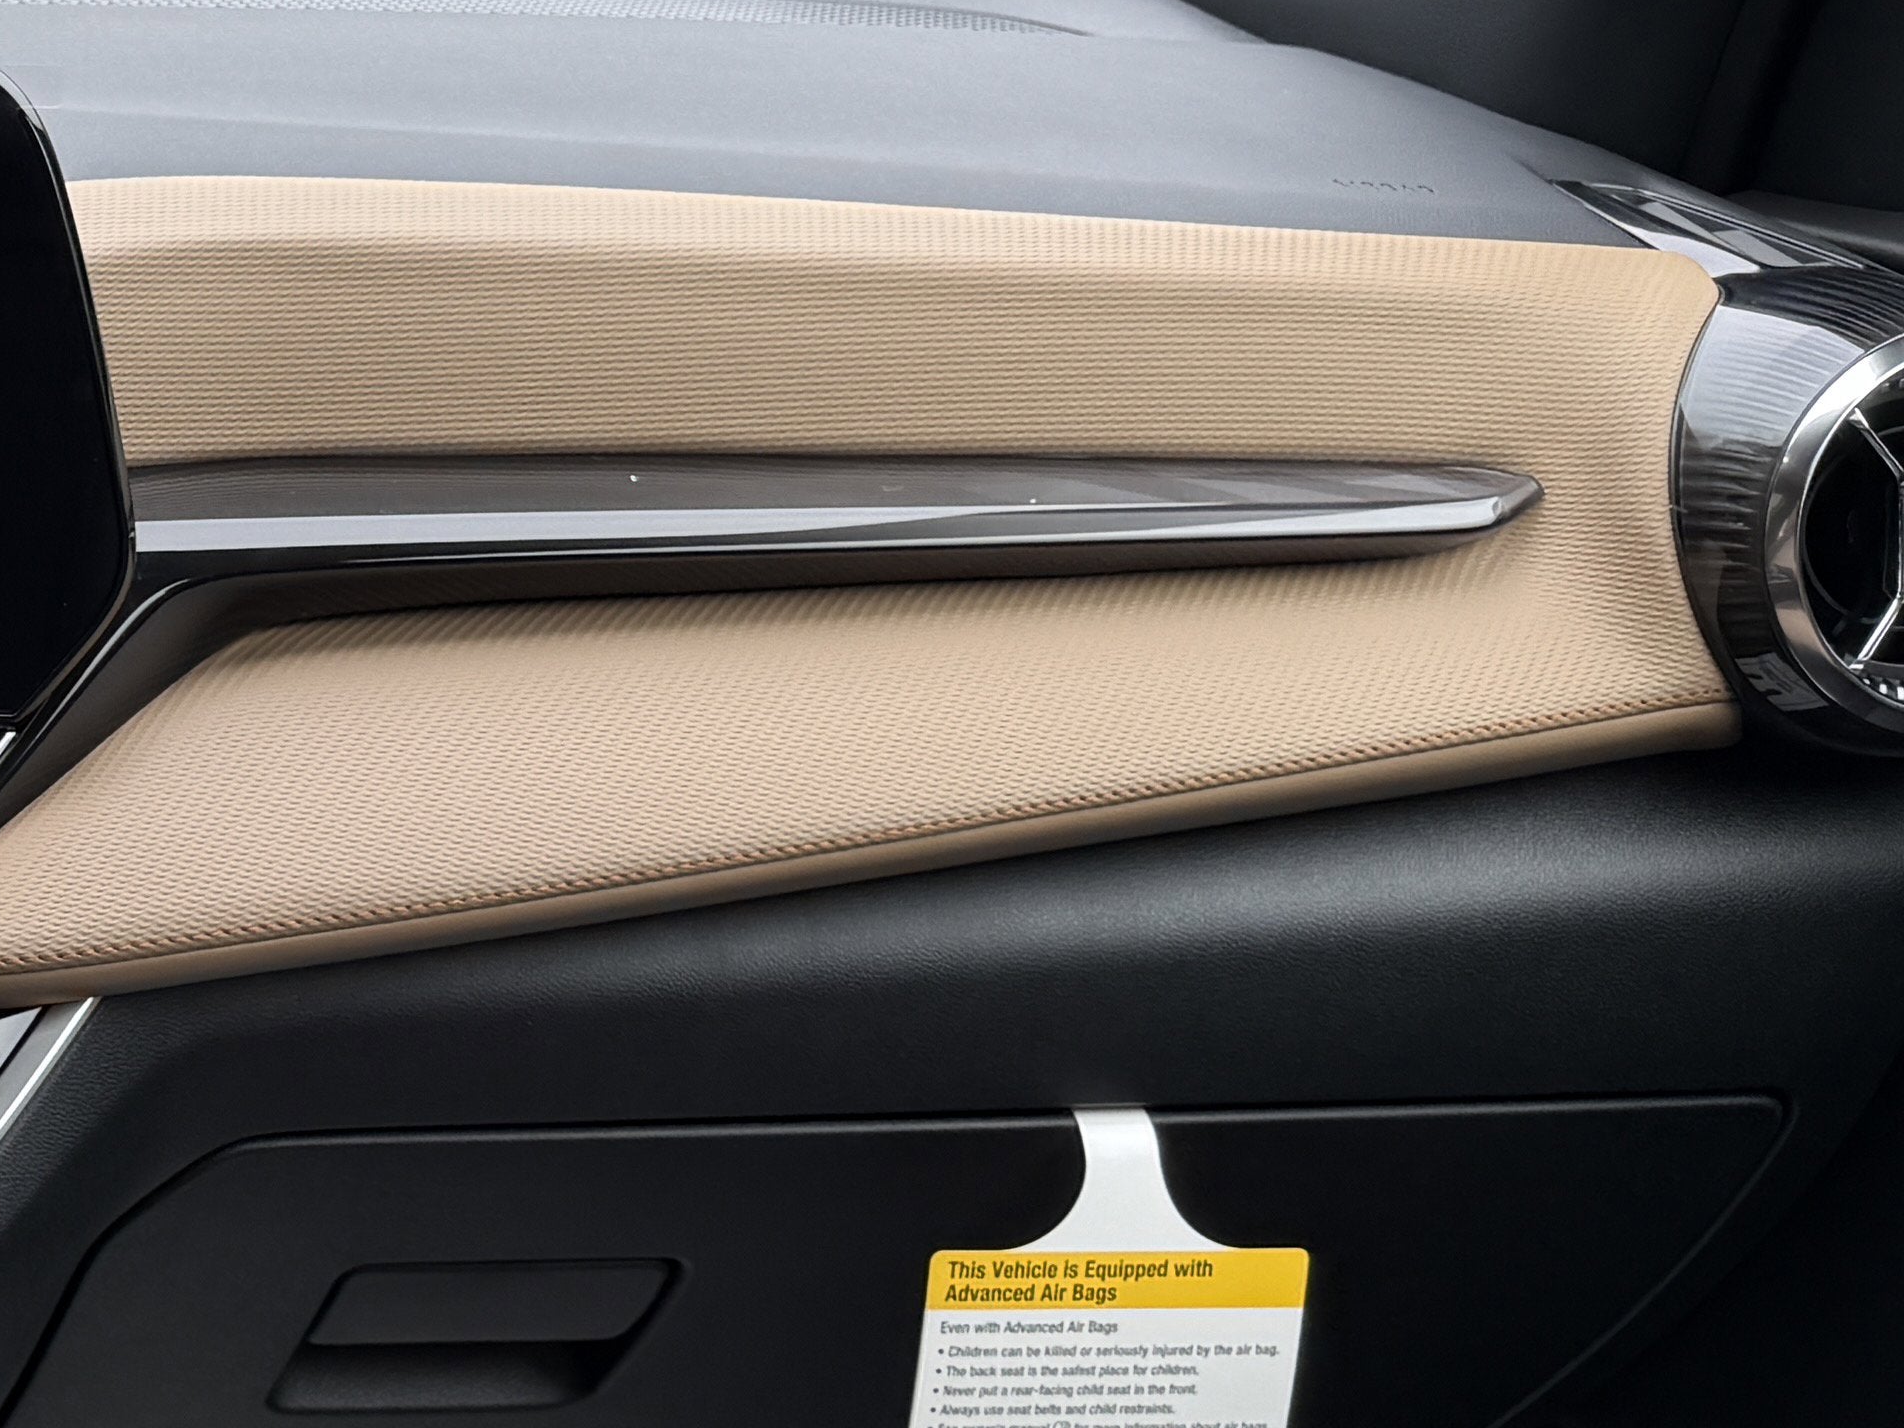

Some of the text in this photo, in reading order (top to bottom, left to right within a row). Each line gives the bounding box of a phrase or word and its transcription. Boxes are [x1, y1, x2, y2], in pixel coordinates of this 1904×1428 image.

[948, 1261, 986, 1279] This
[992, 1260, 1058, 1279] Vehicle
[1084, 1259, 1169, 1282] Equipped
[1174, 1259, 1213, 1277] with
[945, 1283, 1117, 1305] Advanced Air Bags
[940, 1320, 1118, 1336] Even with Advanced Air Bags
[948, 1345, 998, 1357] Children
[1001, 1347, 1023, 1357] can
[1027, 1345, 1041, 1357] be
[1080, 1347, 1092, 1357] or
[1096, 1345, 1148, 1358] seriously
[1152, 1344, 1192, 1358] injured
[1196, 1345, 1210, 1359] by
[1214, 1344, 1233, 1356] the
[1236, 1344, 1252, 1356] air
[1255, 1344, 1280, 1357] bag.
[947, 1365, 967, 1377] The
[1041, 1365, 1059, 1377] the
[1098, 1365, 1129, 1378] place
[1133, 1364, 1147, 1376] for
[1148, 1384, 1165, 1395] the
[940, 1404, 980, 1417] Always
[1089, 1404, 1117, 1414] child
